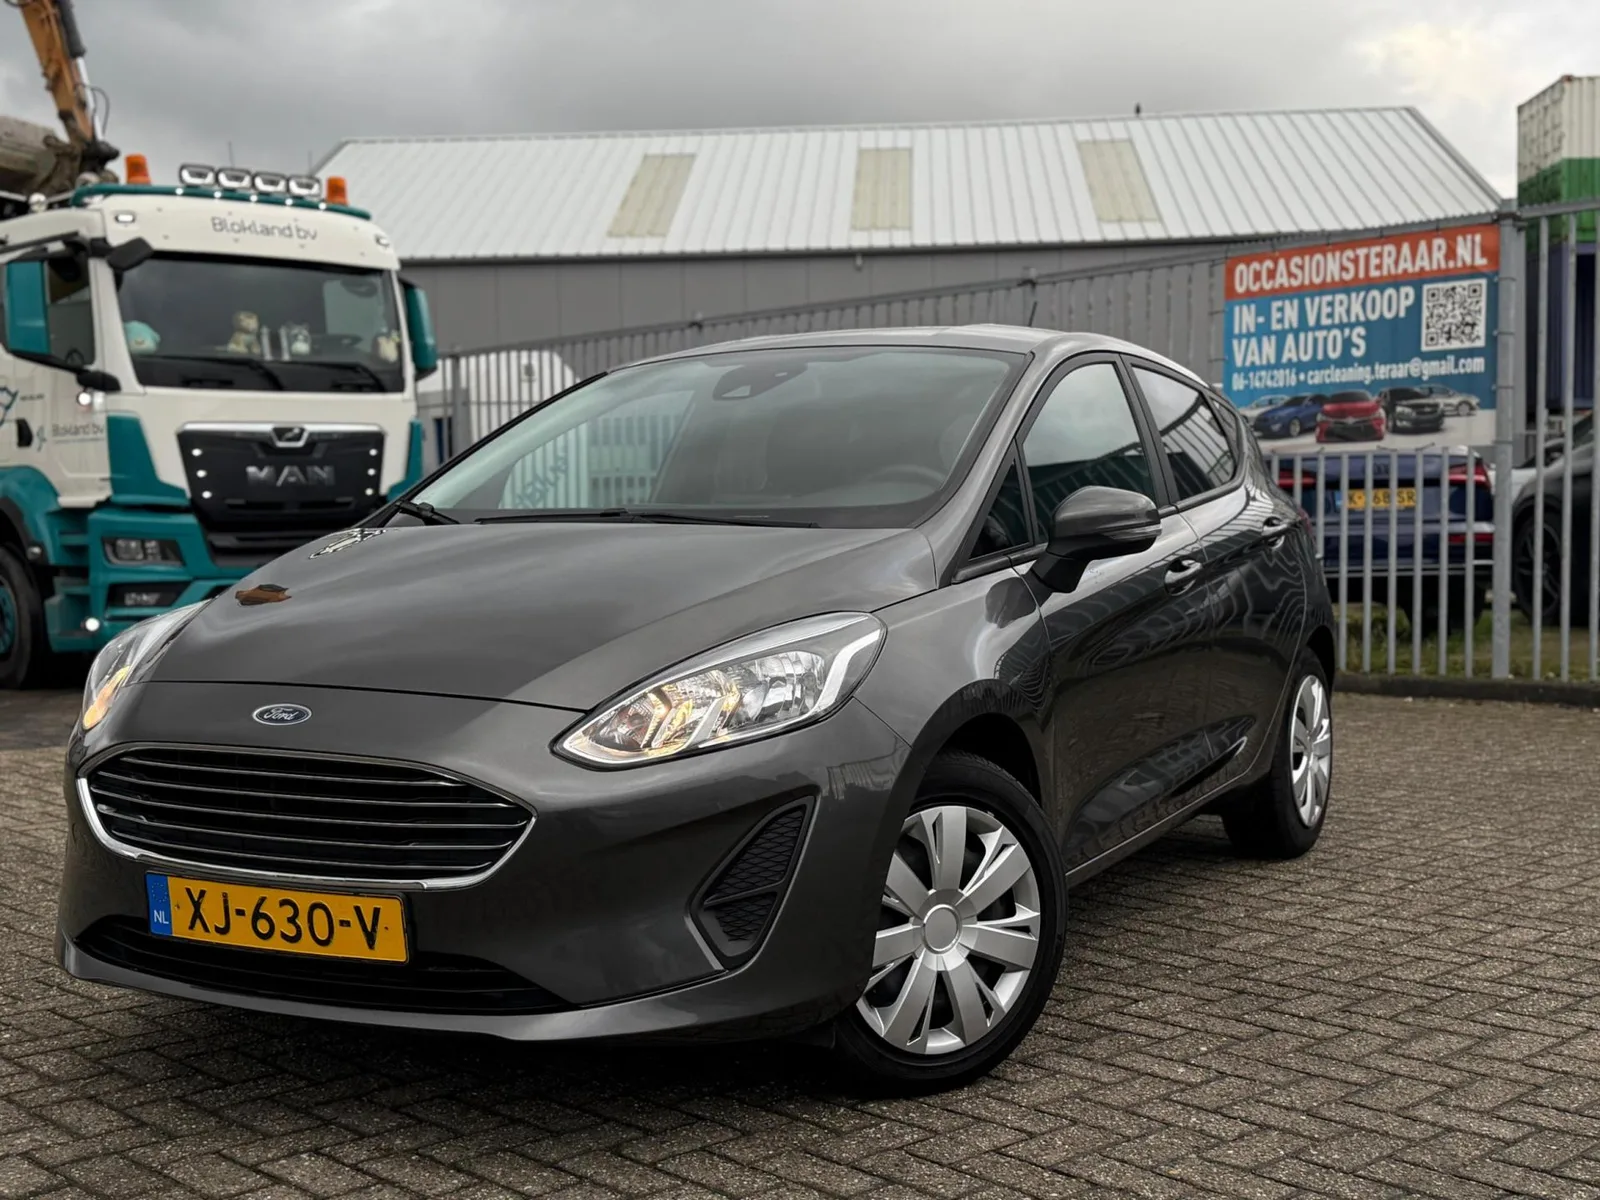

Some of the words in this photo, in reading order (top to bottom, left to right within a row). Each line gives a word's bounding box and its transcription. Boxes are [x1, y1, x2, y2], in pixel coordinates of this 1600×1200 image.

[211, 216, 294, 238] Blokland
[295, 224, 318, 240] bv
[1234, 233, 1488, 294] OCCASIONSTERAAR.NL
[1233, 304, 1265, 335] IN-
[1271, 299, 1299, 331] EN
[1304, 285, 1415, 327] VERKOOP
[1232, 335, 1276, 368] VAN
[1281, 326, 1366, 364] AUTO'S
[1232, 368, 1297, 391] 06-14742016
[1307, 354, 1485, 386] carcleaning.teraar@gmail.com
[246, 465, 335, 487] MAN
[263, 707, 299, 720] Ford
[154, 909, 170, 925] NL
[184, 887, 381, 951] XJ-630-V
